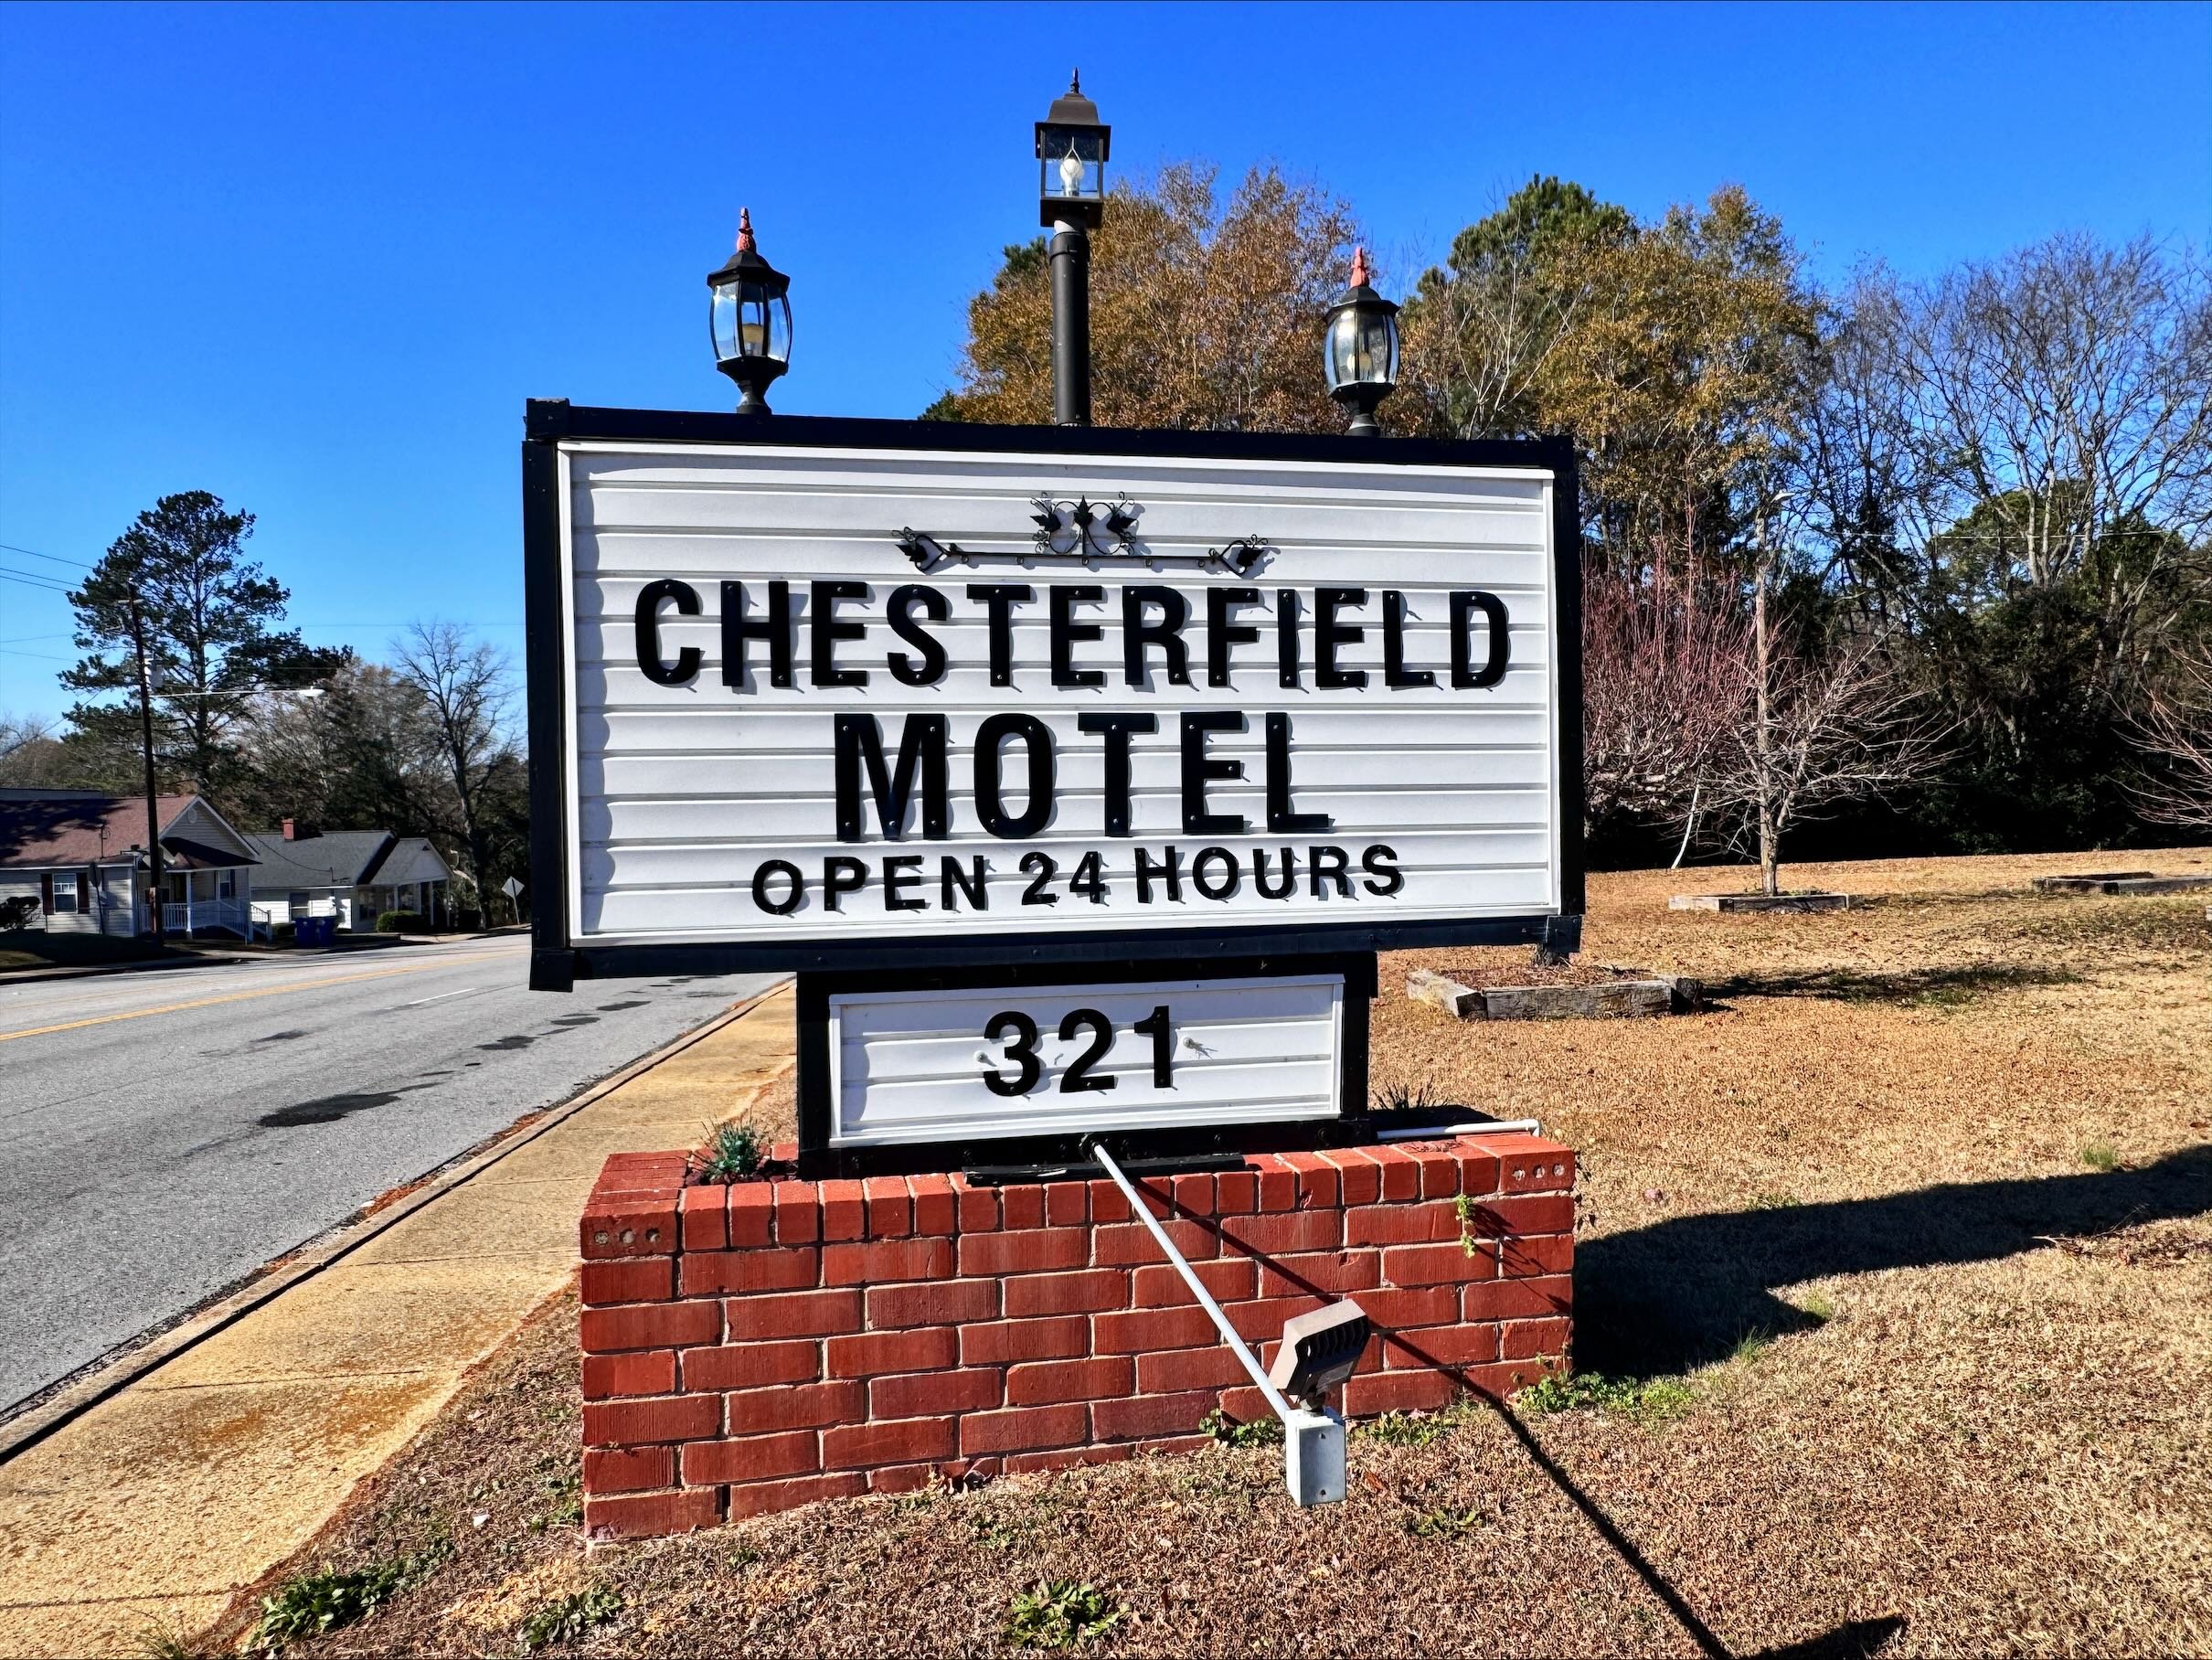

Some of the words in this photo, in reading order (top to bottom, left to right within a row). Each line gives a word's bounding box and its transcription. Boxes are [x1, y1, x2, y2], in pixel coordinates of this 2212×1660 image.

[634, 578, 1511, 689] CHESTERFIELD
[834, 710, 1331, 843] MOTEL
[750, 855, 987, 915] OPEN
[1019, 851, 1106, 905] 24
[1134, 844, 1402, 903] HOURS
[983, 1005, 1174, 1097] 321
